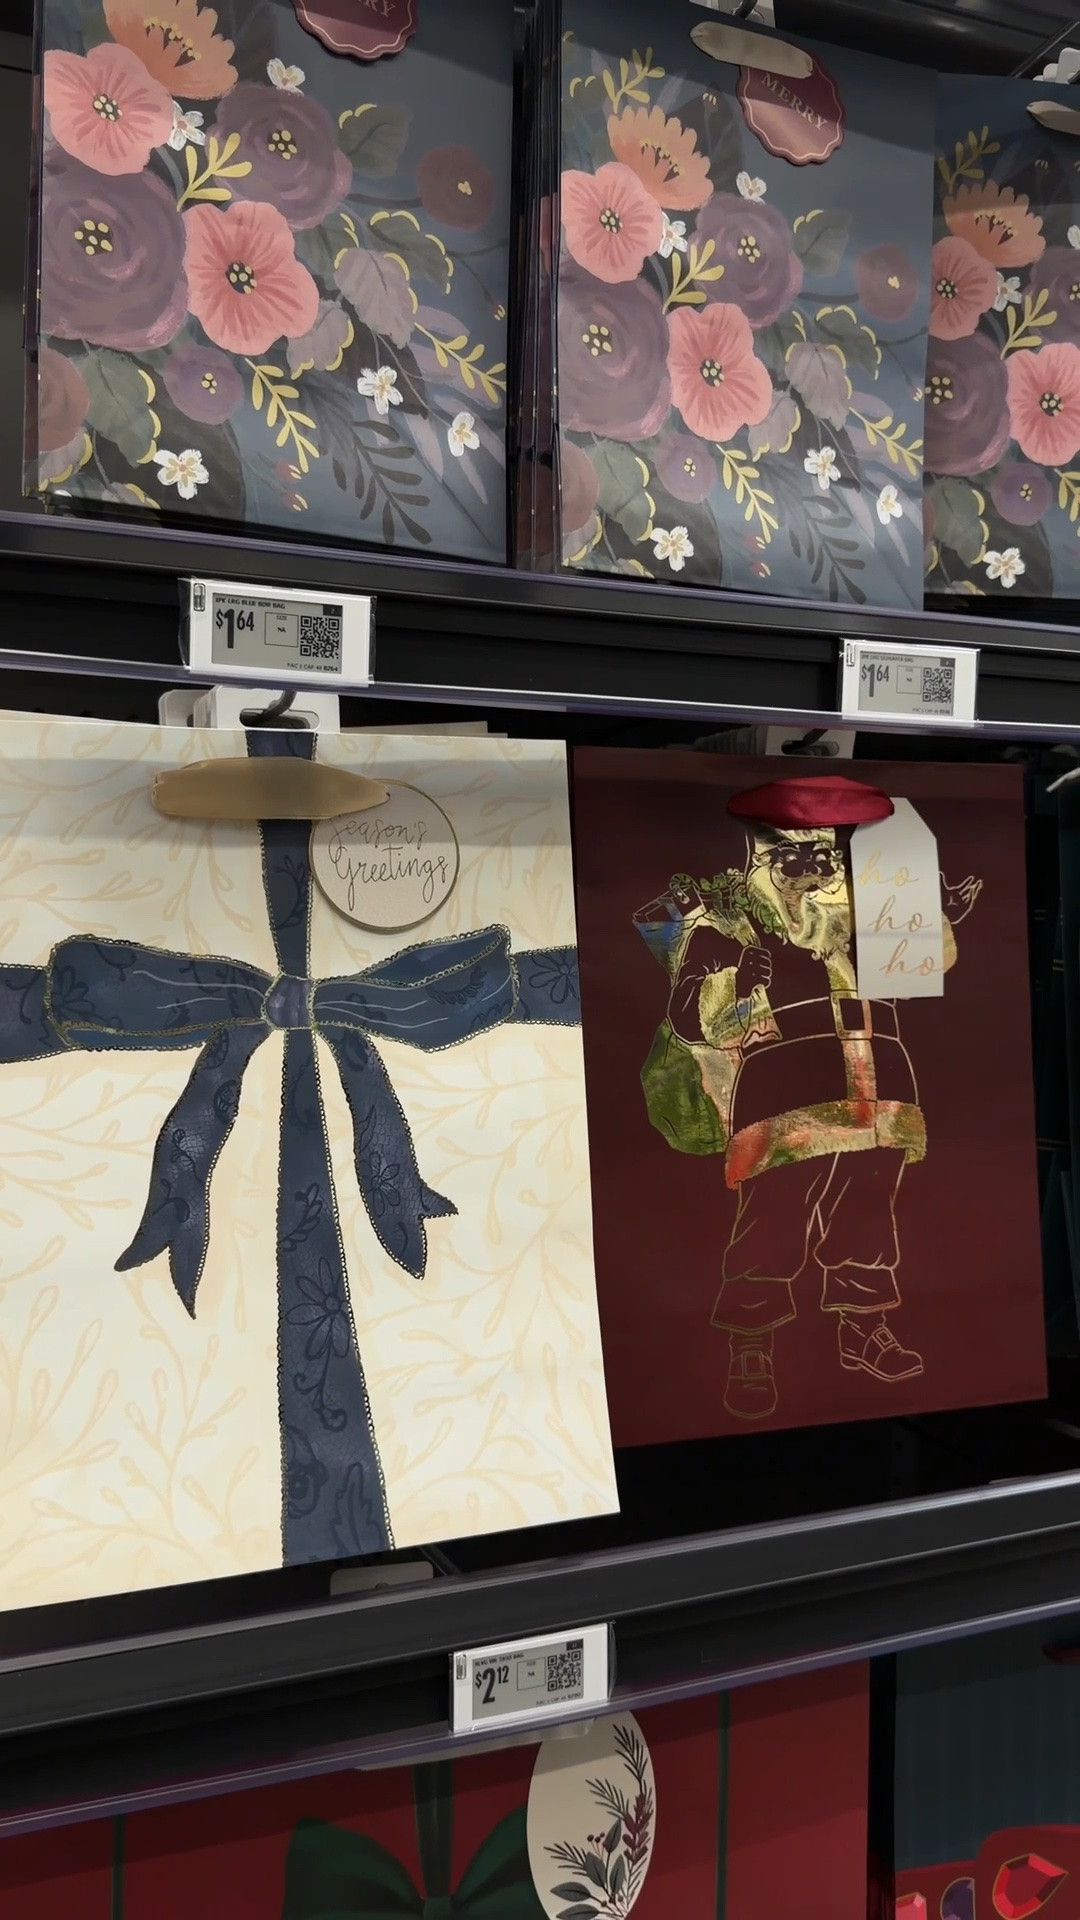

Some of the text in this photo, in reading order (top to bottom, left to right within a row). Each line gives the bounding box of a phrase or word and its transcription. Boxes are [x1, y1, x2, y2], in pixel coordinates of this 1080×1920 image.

[761, 72, 828, 130] MERRY
[241, 599, 256, 607] BLUE
[272, 601, 286, 609] BAG
[329, 818, 428, 864] Season's
[334, 843, 449, 911] Greetings
[853, 849, 920, 887] ho
[867, 895, 933, 934] ho
[878, 938, 945, 977] ho
